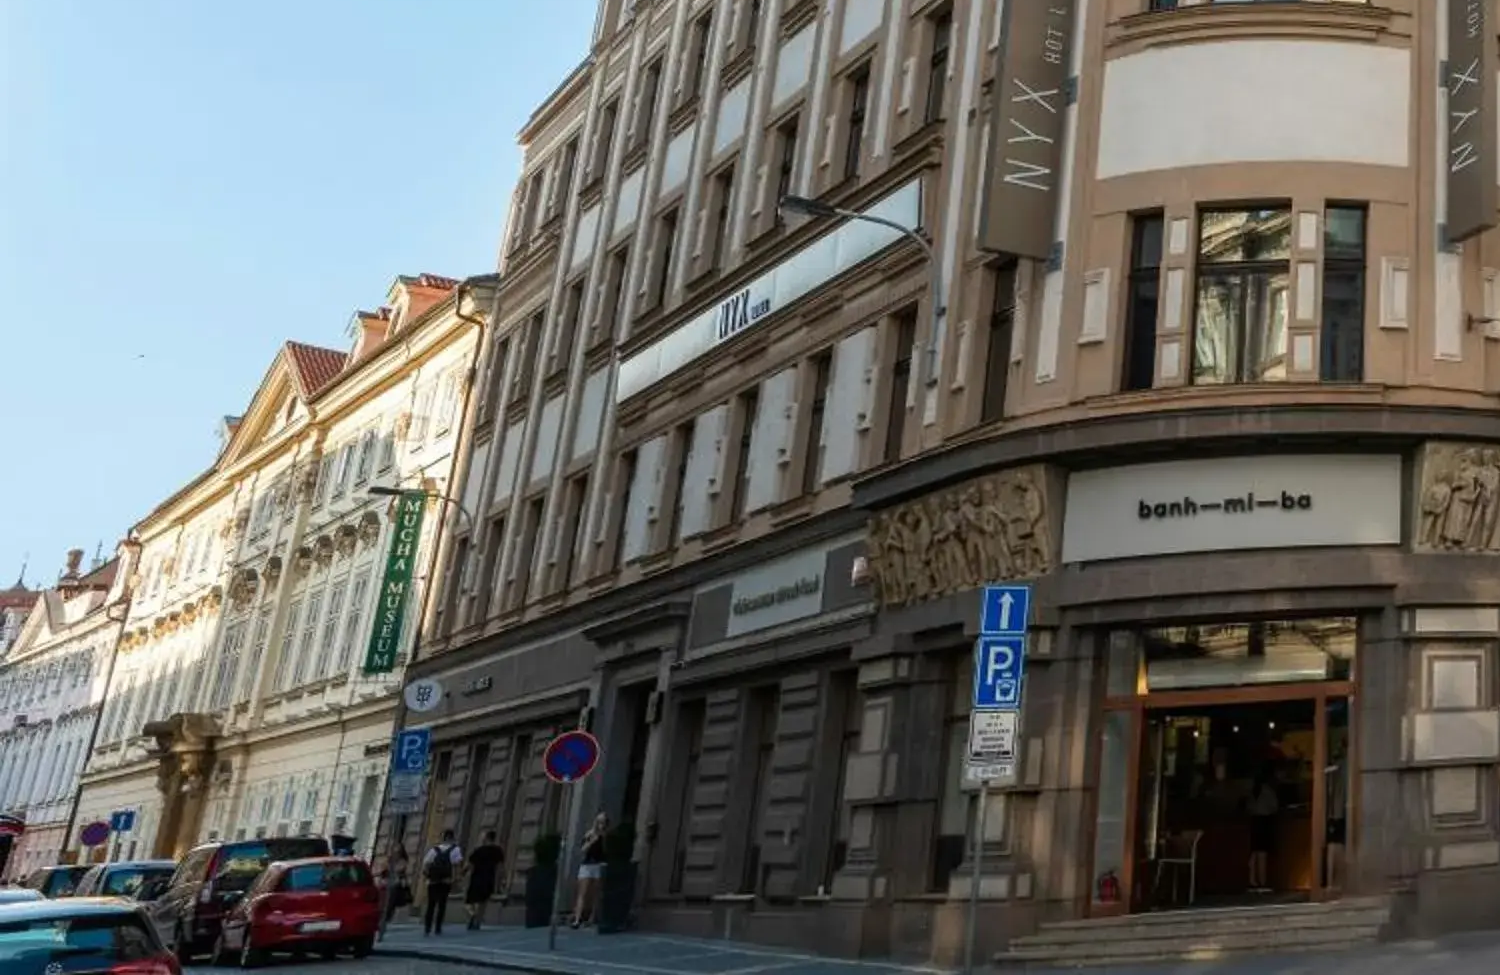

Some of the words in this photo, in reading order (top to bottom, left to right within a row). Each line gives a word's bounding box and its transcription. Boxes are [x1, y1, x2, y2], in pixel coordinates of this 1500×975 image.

[1004, 78, 1058, 190] NYX
[1451, 57, 1479, 172] NYX
[720, 288, 750, 339] NYX
[394, 500, 421, 572] MUCHA
[372, 582, 404, 667] MUSEUM
[987, 645, 1014, 685] P
